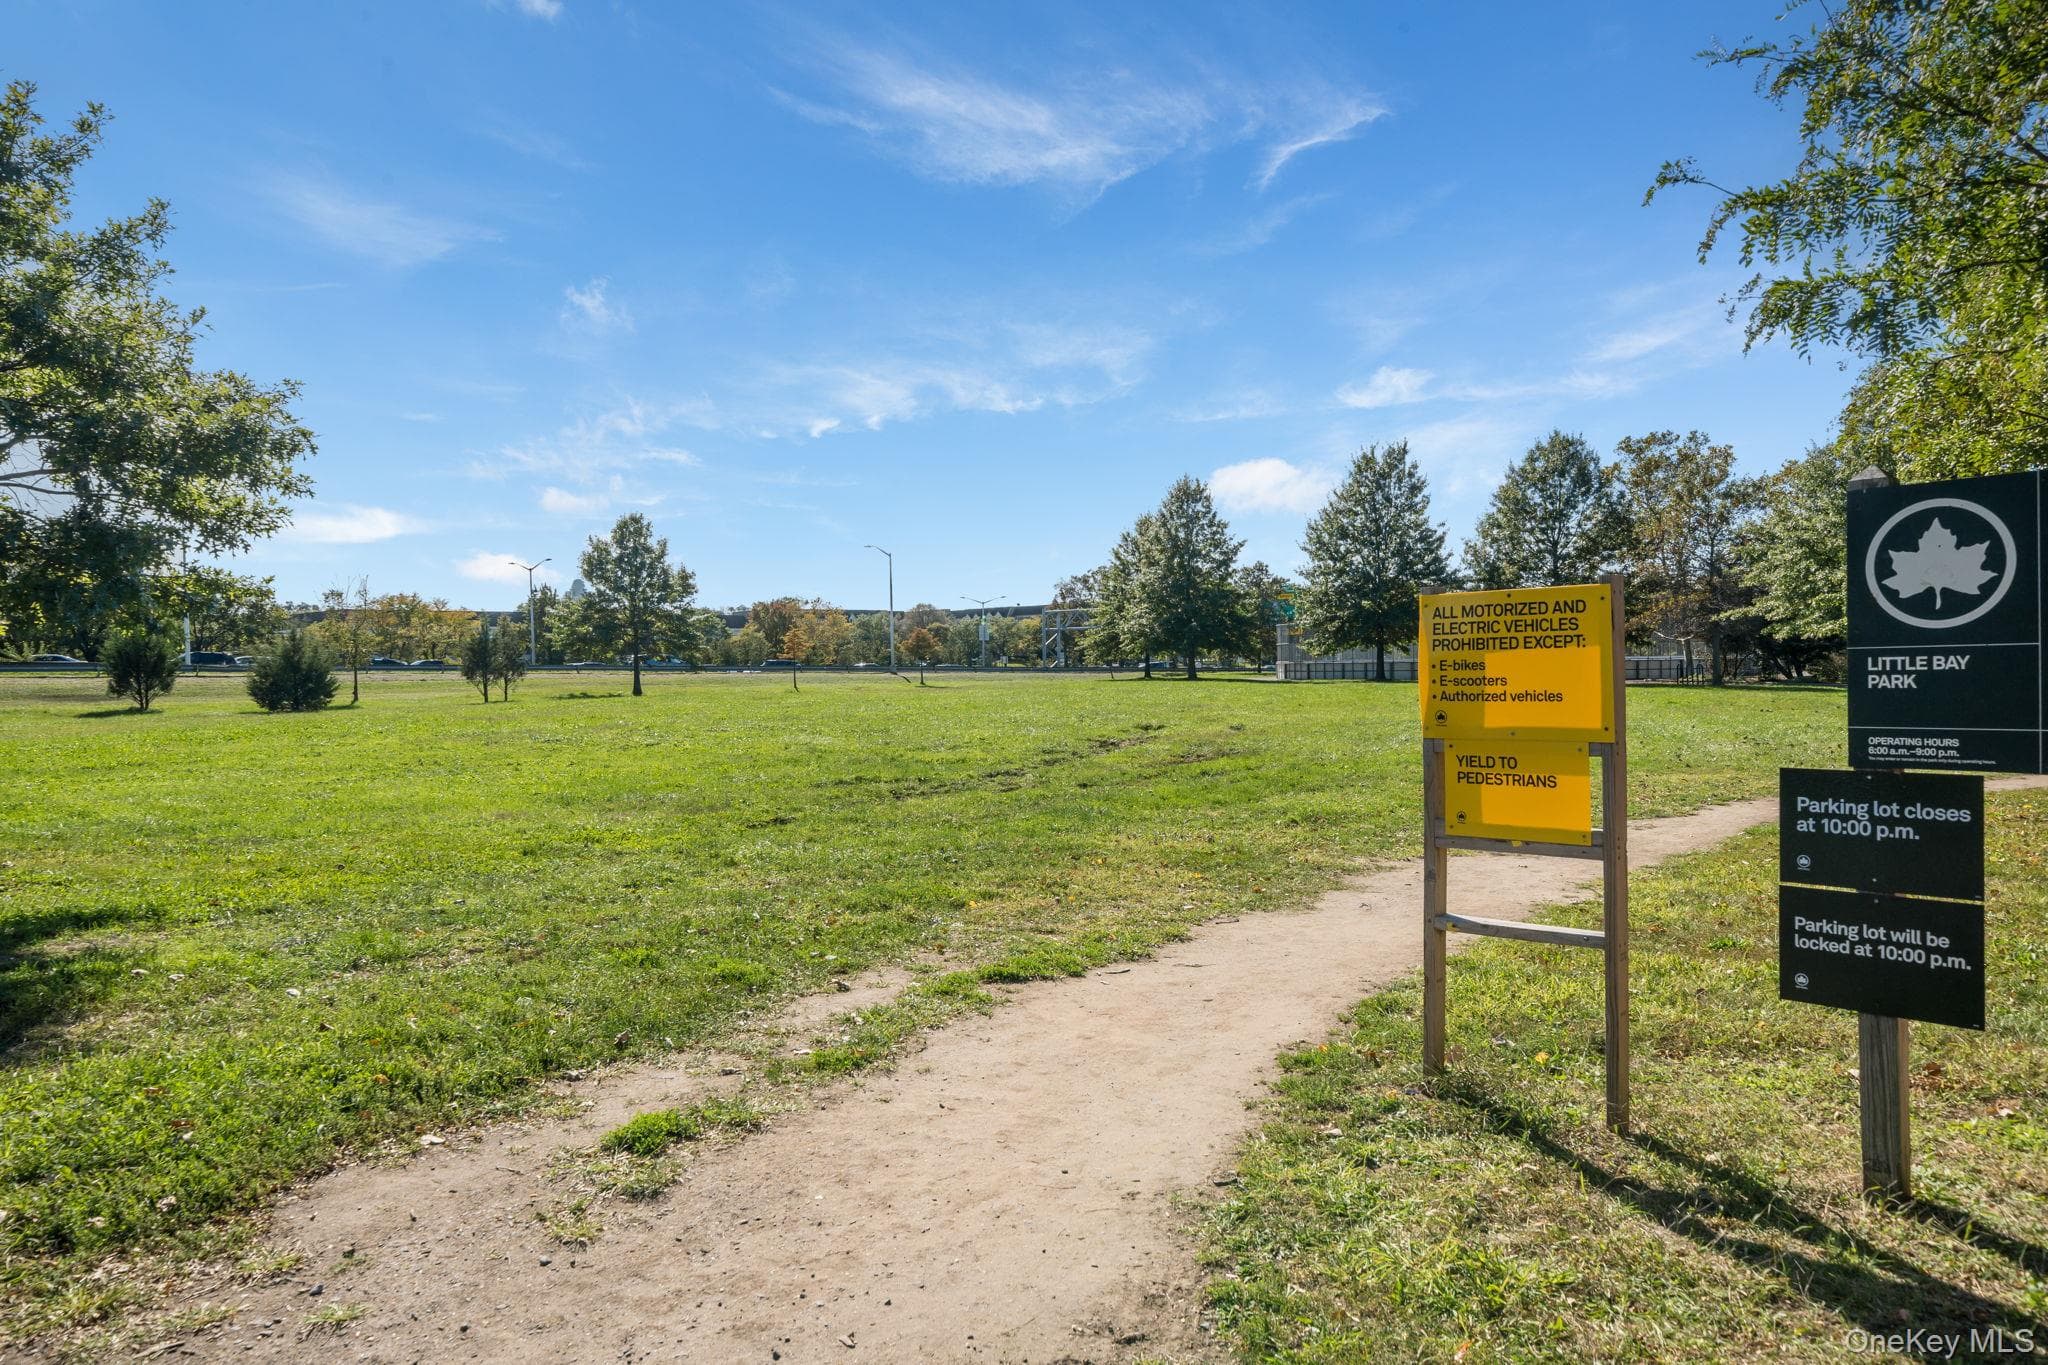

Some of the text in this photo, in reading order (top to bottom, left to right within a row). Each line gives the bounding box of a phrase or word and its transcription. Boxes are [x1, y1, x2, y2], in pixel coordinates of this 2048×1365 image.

[1432, 599, 1587, 620] ALL MOTORIZED AND
[1432, 617, 1579, 636] ELECTRIC VEHICLES
[1432, 634, 1587, 652] PROHIBITED EXCEPT:
[1440, 660, 1486, 671] E-bikes
[1867, 655, 1970, 671] LITTLE BAY
[1440, 674, 1508, 687] E-scooters
[1867, 674, 1917, 689] PARK
[1440, 690, 1563, 702] Authorized vehicles
[1868, 737, 1960, 747] OPERATING HOURS
[1938, 749, 1960, 758] p.m.
[1456, 755, 1518, 770] YIELD TO
[1457, 771, 1557, 788] PEDESTRIANS
[1796, 797, 1971, 823] Parking lot closes
[1796, 818, 1920, 841] at 10:00 p.m.
[1794, 916, 1950, 948] Parking lot will be
[1794, 934, 1972, 971] locked at 10:00 p.m.
